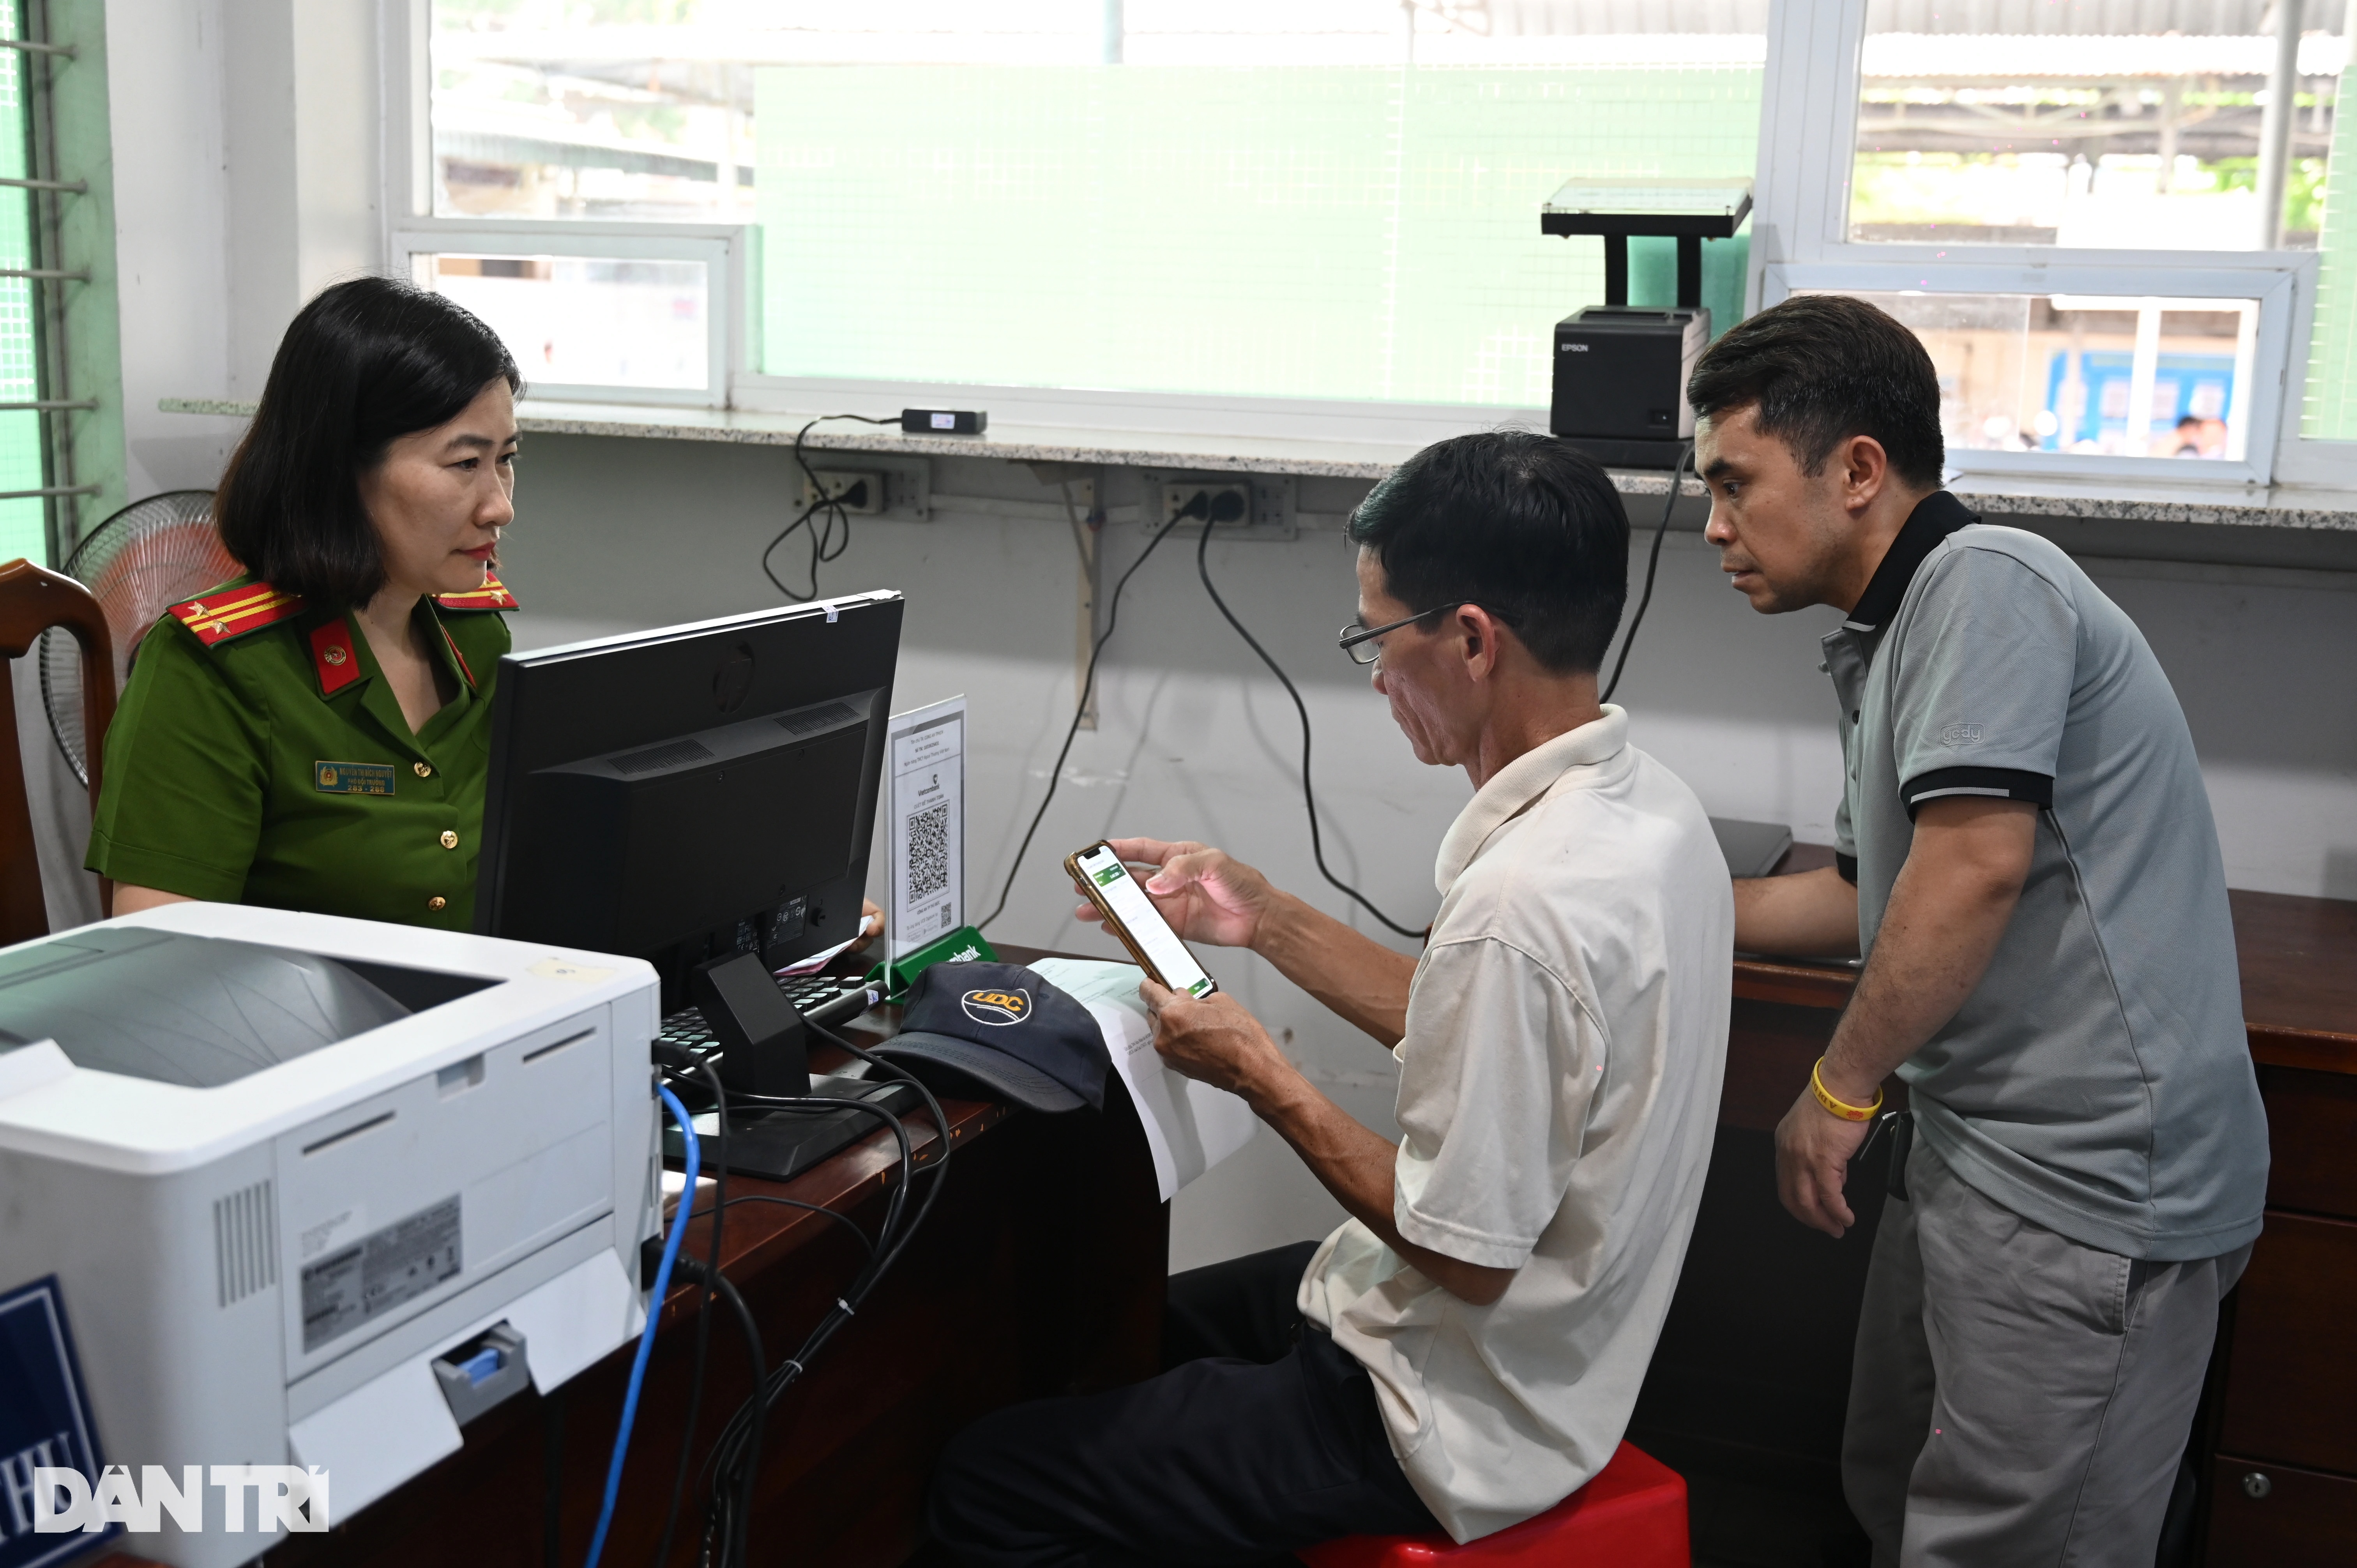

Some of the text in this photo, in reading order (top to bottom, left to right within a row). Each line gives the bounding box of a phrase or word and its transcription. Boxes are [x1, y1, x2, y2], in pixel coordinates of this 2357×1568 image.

[1561, 344, 1588, 352] EPSON
[918, 783, 940, 796] Vietcombank
[972, 992, 1024, 1011] UDC
